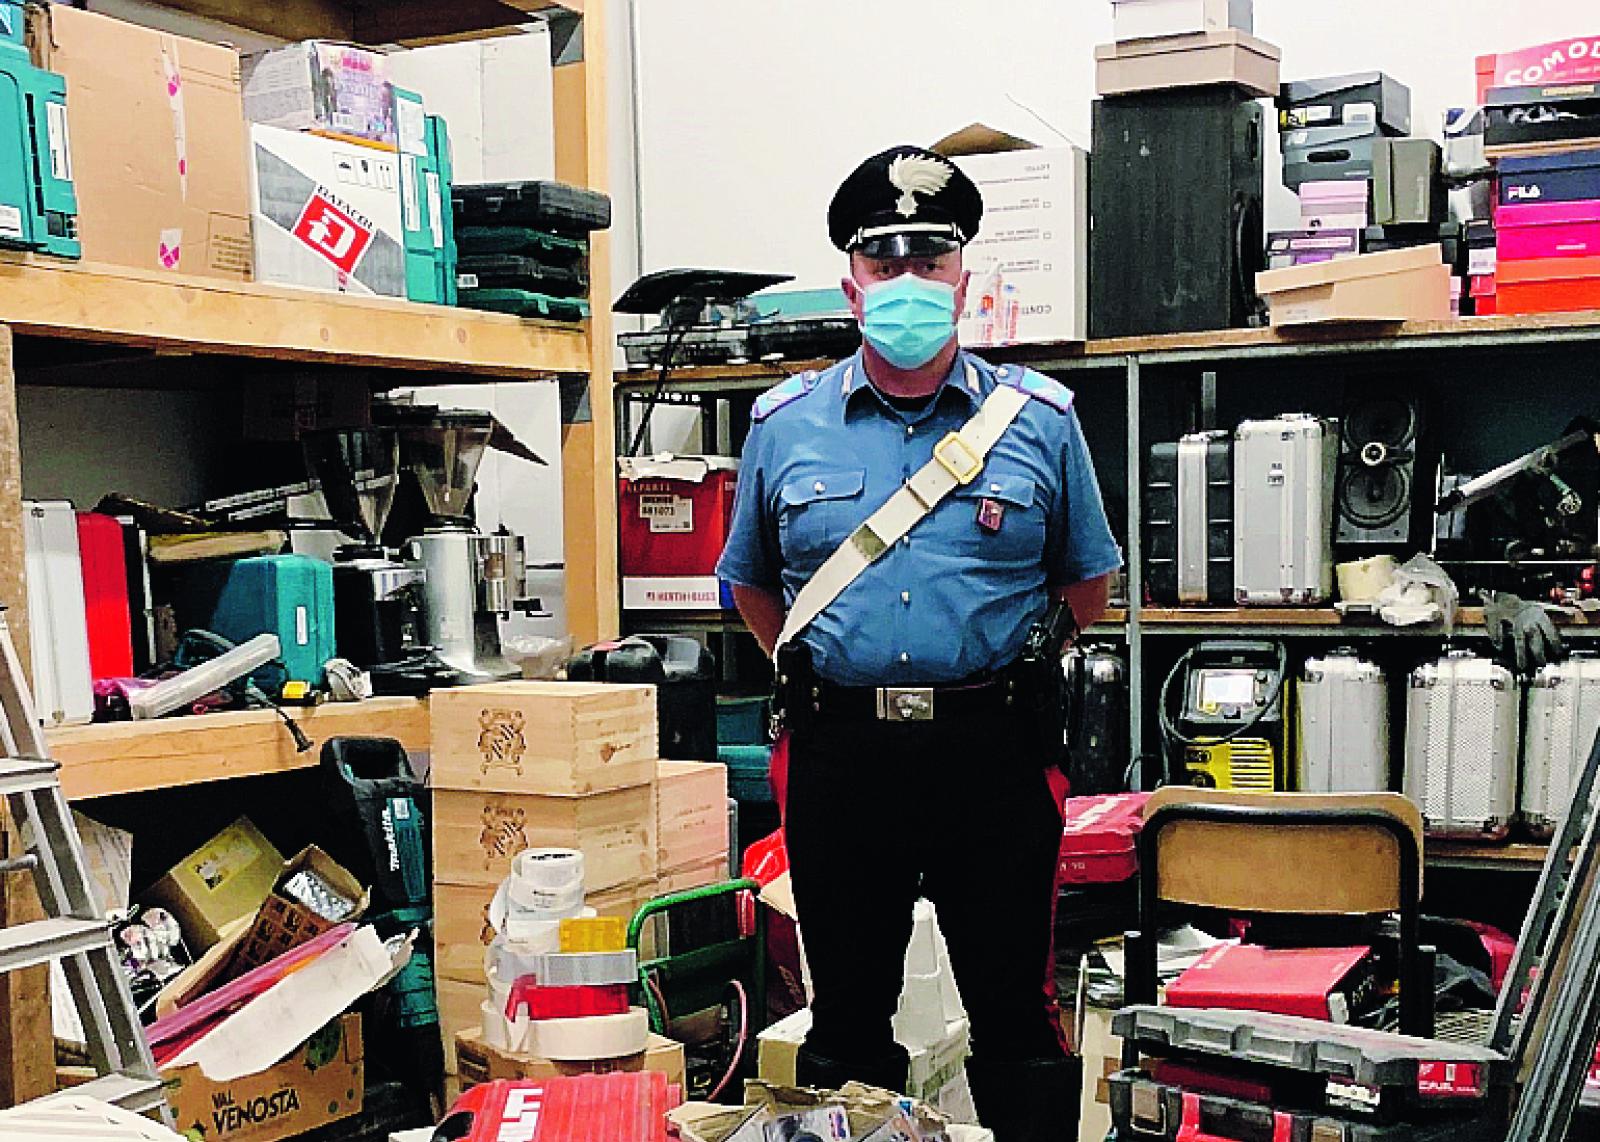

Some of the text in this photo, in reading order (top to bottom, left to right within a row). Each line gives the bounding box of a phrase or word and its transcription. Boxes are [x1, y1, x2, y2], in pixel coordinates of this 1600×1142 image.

[1508, 185, 1541, 200] FILA
[211, 1088, 235, 1109] VAL
[212, 1088, 300, 1134] VENOSTA
